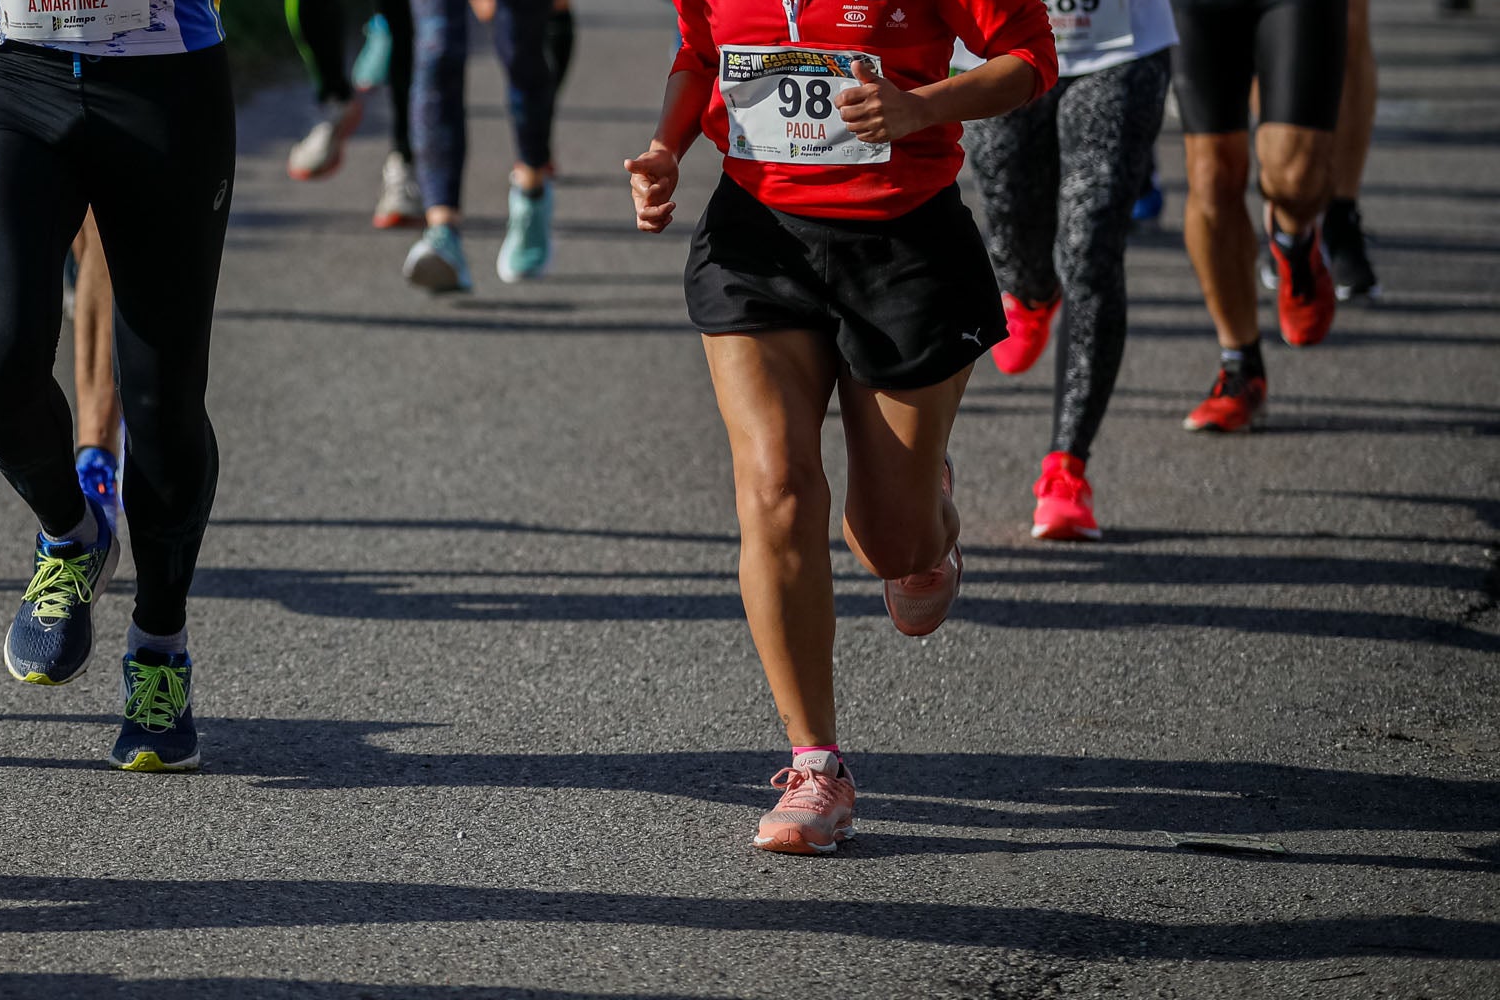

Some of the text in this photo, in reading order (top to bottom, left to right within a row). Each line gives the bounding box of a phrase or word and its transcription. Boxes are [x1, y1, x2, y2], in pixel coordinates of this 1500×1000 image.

[64, 15, 96, 24] olimpo
[847, 13, 863, 21] KIA
[750, 54, 764, 70] VII
[762, 51, 820, 64] CARRERA
[728, 69, 742, 78] Ruta
[742, 70, 751, 78] de
[778, 77, 833, 120] 98
[786, 121, 827, 140] PAOLA
[801, 144, 833, 153] olimpo
